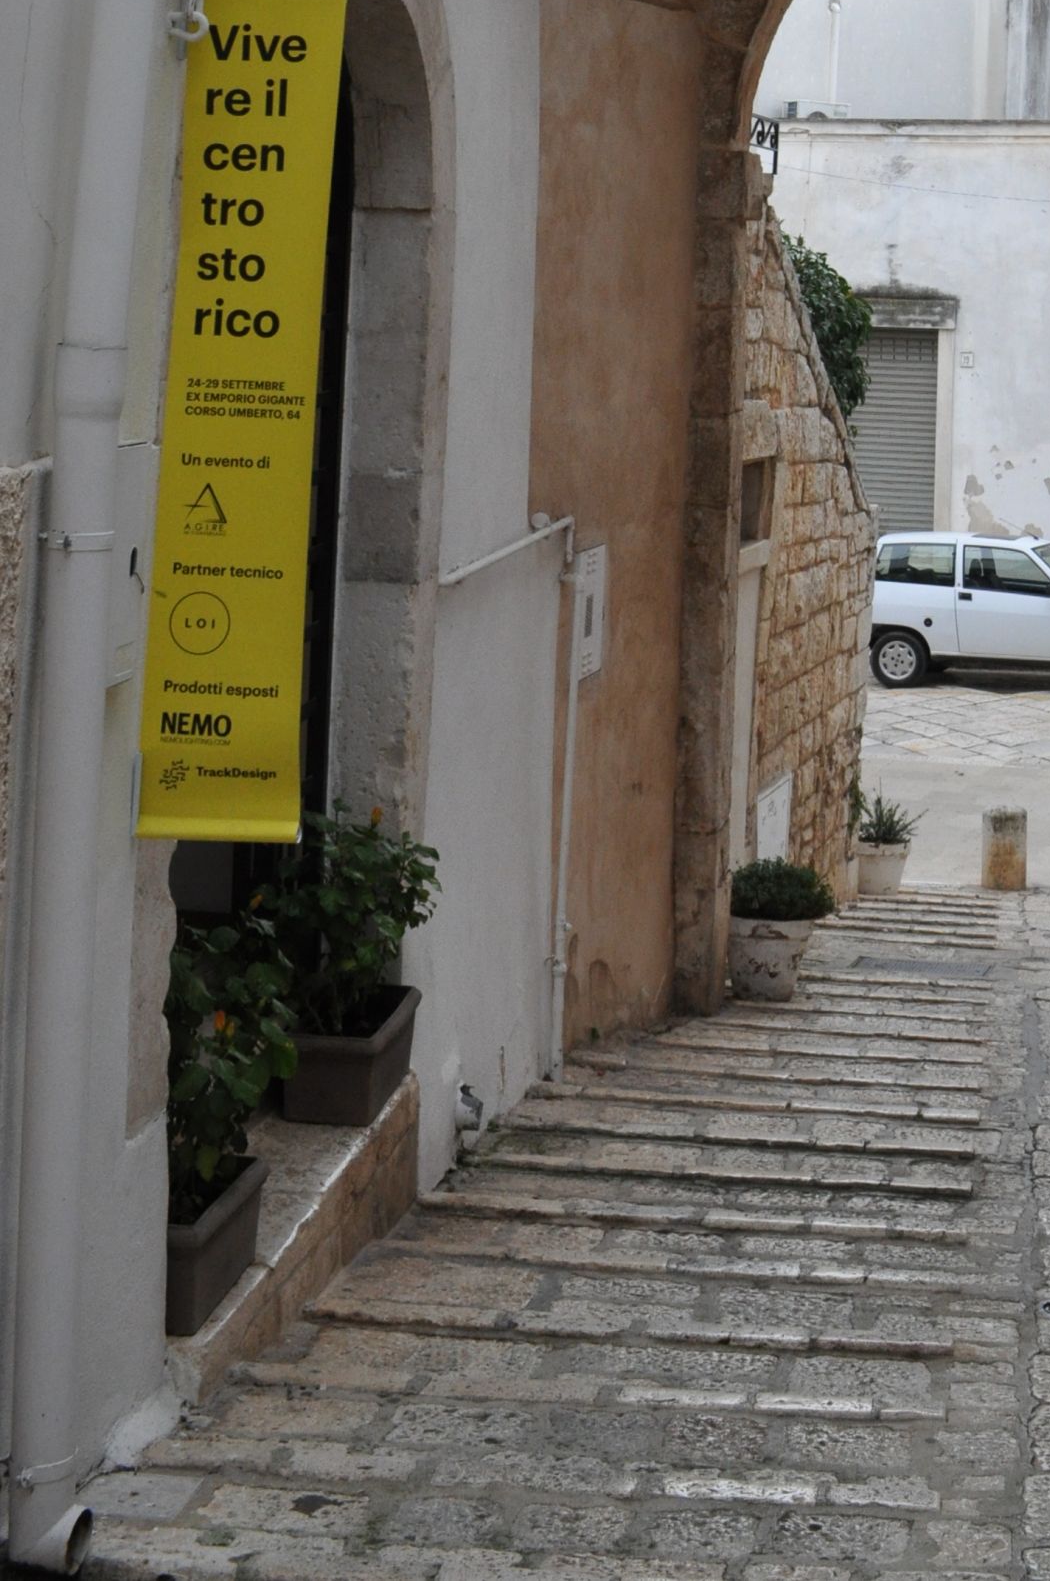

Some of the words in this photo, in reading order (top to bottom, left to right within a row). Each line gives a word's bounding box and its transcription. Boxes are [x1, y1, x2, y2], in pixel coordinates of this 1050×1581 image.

[208, 23, 308, 63] Vive
[205, 86, 251, 117] re
[264, 78, 288, 117] il
[202, 142, 285, 172] cen
[201, 192, 265, 227] tro
[196, 248, 266, 282] sto
[193, 298, 280, 338] rico
[187, 378, 219, 389] 24-29
[221, 379, 285, 391] SETTEMBRE
[186, 392, 200, 402] EX
[203, 392, 255, 404] EMPORIO
[257, 395, 306, 406] GIGANTE
[184, 406, 226, 417] CORSO
[228, 407, 284, 420] UMBERTO,
[287, 410, 300, 419] 64
[181, 453, 201, 466] Un
[204, 456, 254, 468] evento
[256, 456, 270, 469] di
[173, 562, 226, 577] Partner
[229, 566, 284, 580] tecnico
[164, 680, 222, 695] Prodotti
[226, 685, 279, 699] esposti
[160, 711, 232, 738] NEMO
[196, 766, 277, 781] TrackDesign
